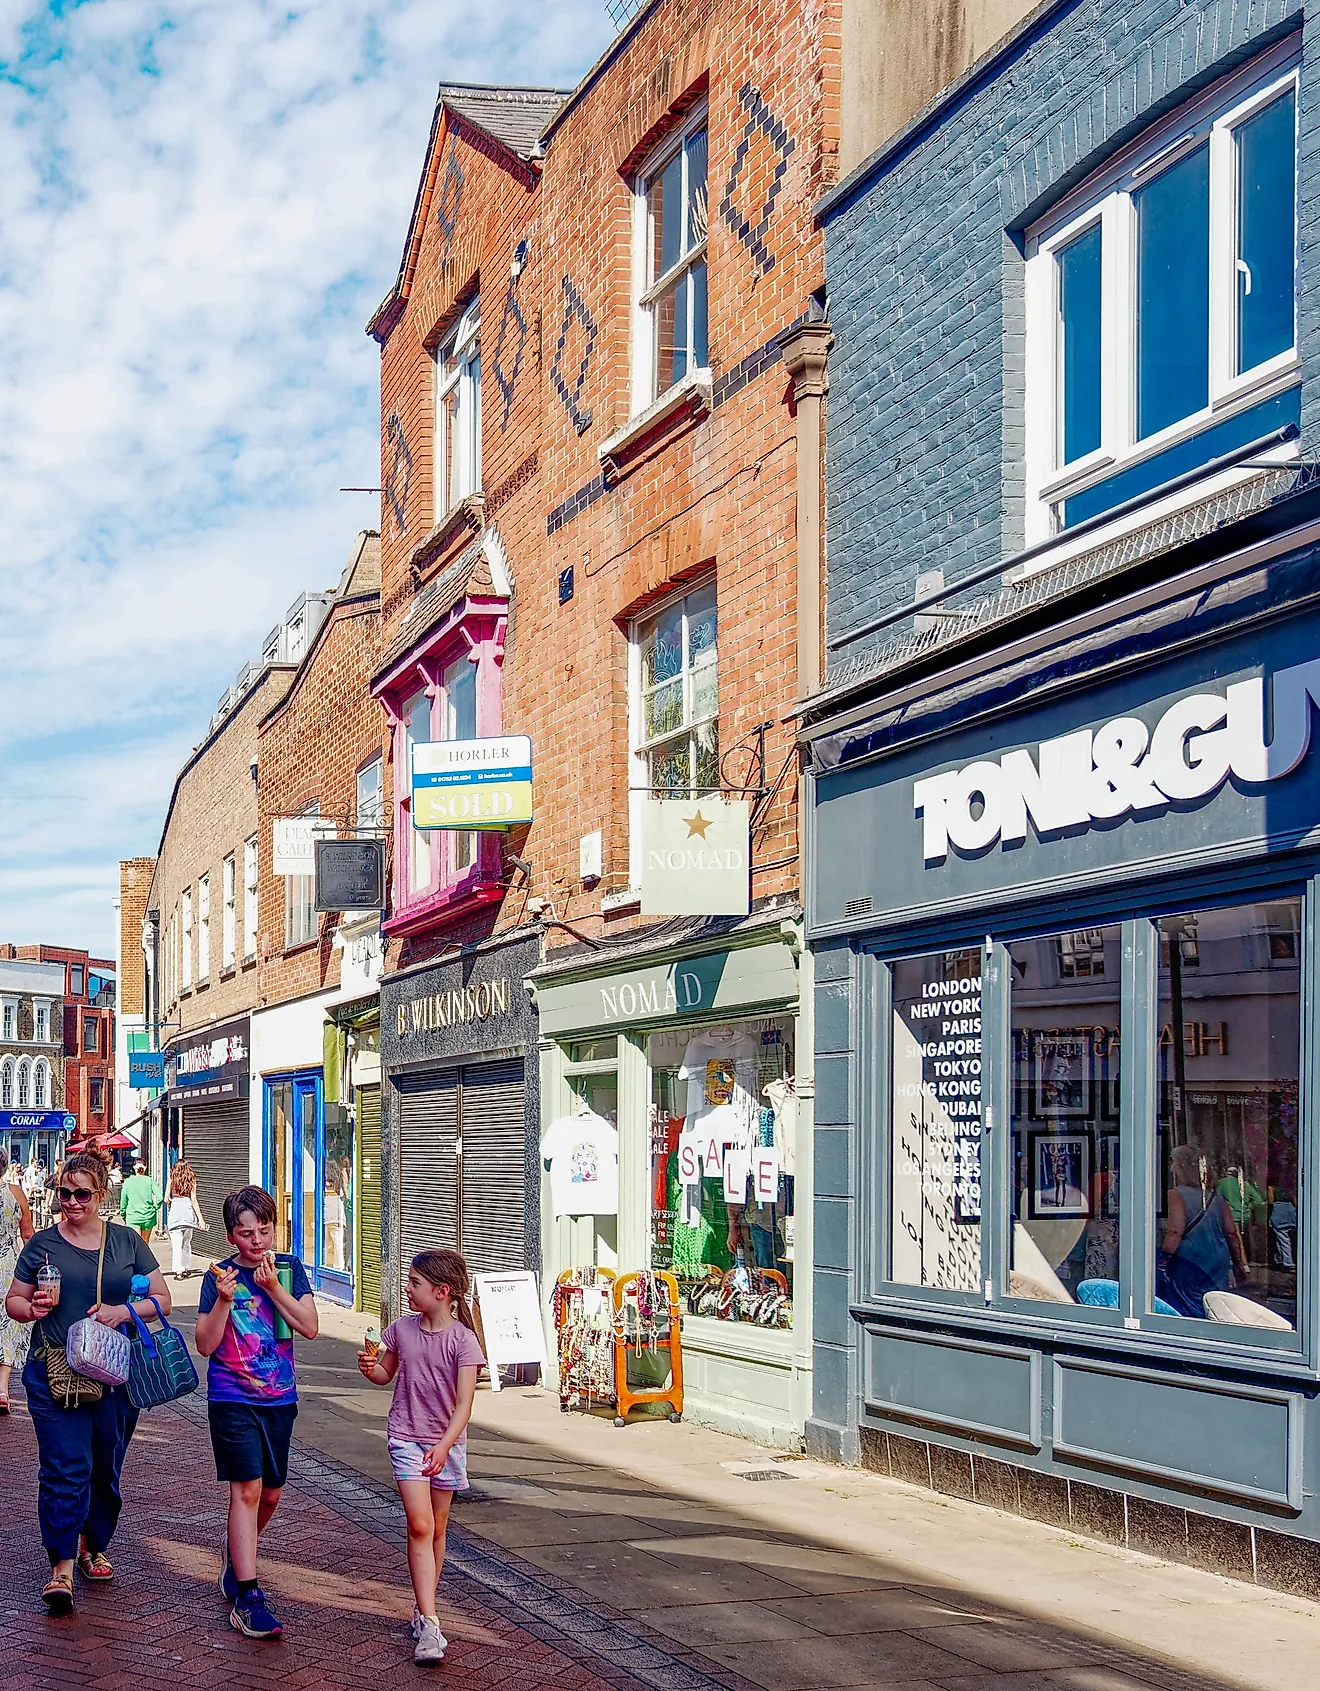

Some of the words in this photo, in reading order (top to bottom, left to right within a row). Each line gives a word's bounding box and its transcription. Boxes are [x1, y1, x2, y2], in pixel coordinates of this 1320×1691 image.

[449, 748, 510, 761] HORLER
[914, 659, 1320, 859] TONI&GU
[429, 791, 513, 820] SOLD
[650, 849, 743, 870] NOMAD
[600, 972, 702, 1019] NOMAD
[922, 976, 981, 998] LONDON
[411, 977, 510, 1034] WILKINSON
[910, 1002, 940, 1020] NEW
[941, 997, 981, 1016] YORK
[942, 1018, 981, 1036] PARIS
[905, 1038, 981, 1058] SINGAPORE
[131, 1062, 162, 1072] RUSH
[934, 1059, 981, 1077] TOKYO
[898, 1081, 937, 1098] HONG
[939, 1079, 981, 1096] KONG
[940, 1100, 981, 1117] DUBAI
[11, 1116, 40, 1126] CORAL
[929, 1121, 981, 1137] BEIJING
[928, 1141, 981, 1158] SYDNEY
[1041, 1142, 1081, 1155] VOGUE
[916, 1182, 981, 1199] TORONTO
